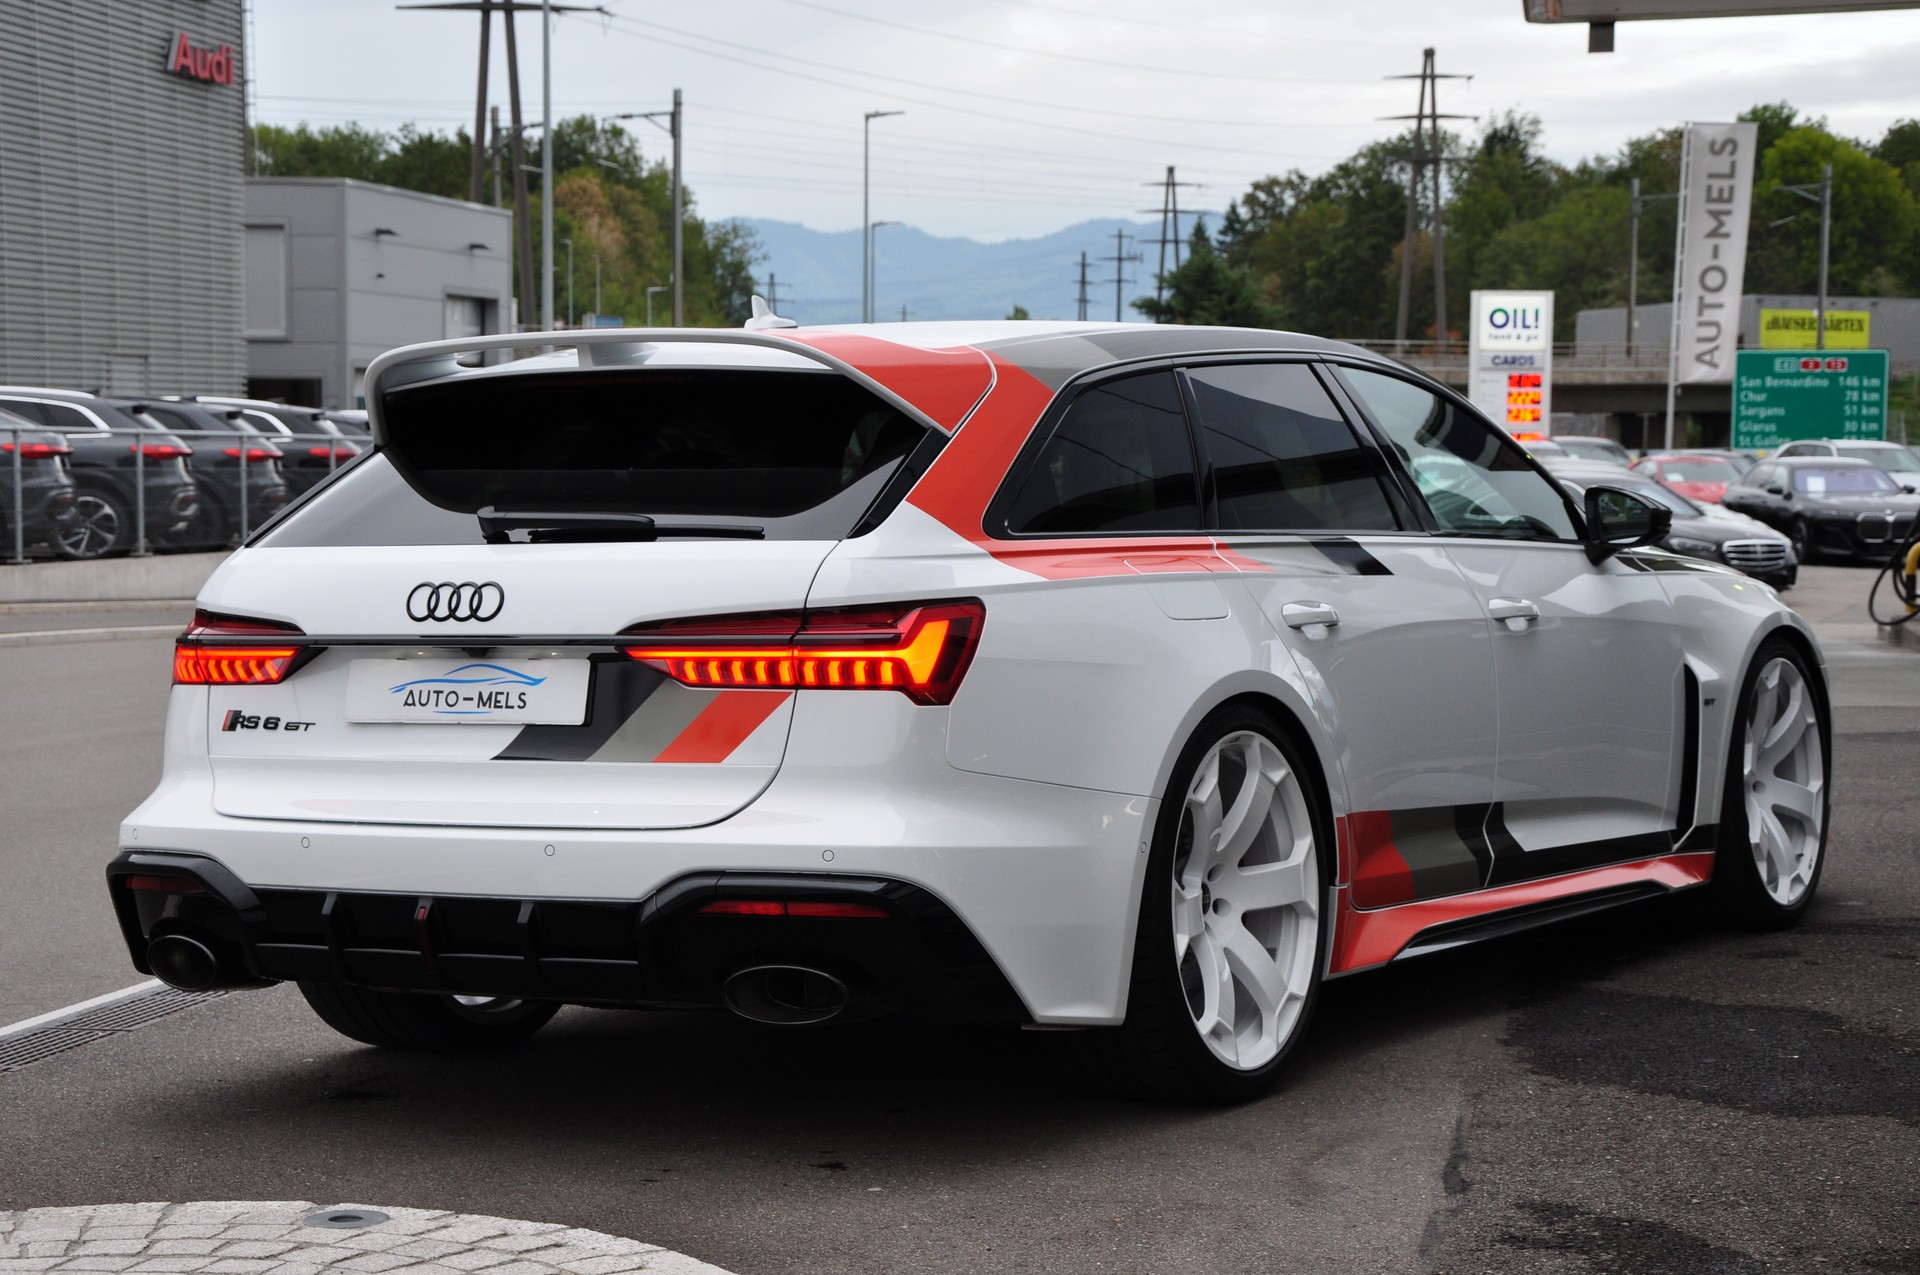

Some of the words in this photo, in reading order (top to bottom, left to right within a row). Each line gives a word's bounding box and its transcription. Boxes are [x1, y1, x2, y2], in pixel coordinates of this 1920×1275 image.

[172, 31, 233, 86] Audi
[1695, 136, 1738, 369] AUTO-MELS
[1489, 308, 1539, 329] OIL!
[1491, 355, 1535, 366] CARDS
[1740, 376, 1762, 388] San
[1765, 376, 1829, 388] Bernardino
[1839, 376, 1859, 388] 146
[1862, 375, 1881, 388] km
[1740, 390, 1767, 402] Chur
[1844, 390, 1859, 402] 78
[1861, 390, 1880, 402] km
[1739, 404, 1785, 420] Sargans
[1844, 404, 1858, 416] 51
[1861, 404, 1880, 416] km
[1738, 420, 1777, 433] Glarus
[1843, 420, 1859, 432] 30
[1860, 420, 1879, 432] km
[402, 689, 528, 710] AUTO-MELS
[283, 721, 316, 732] GT
